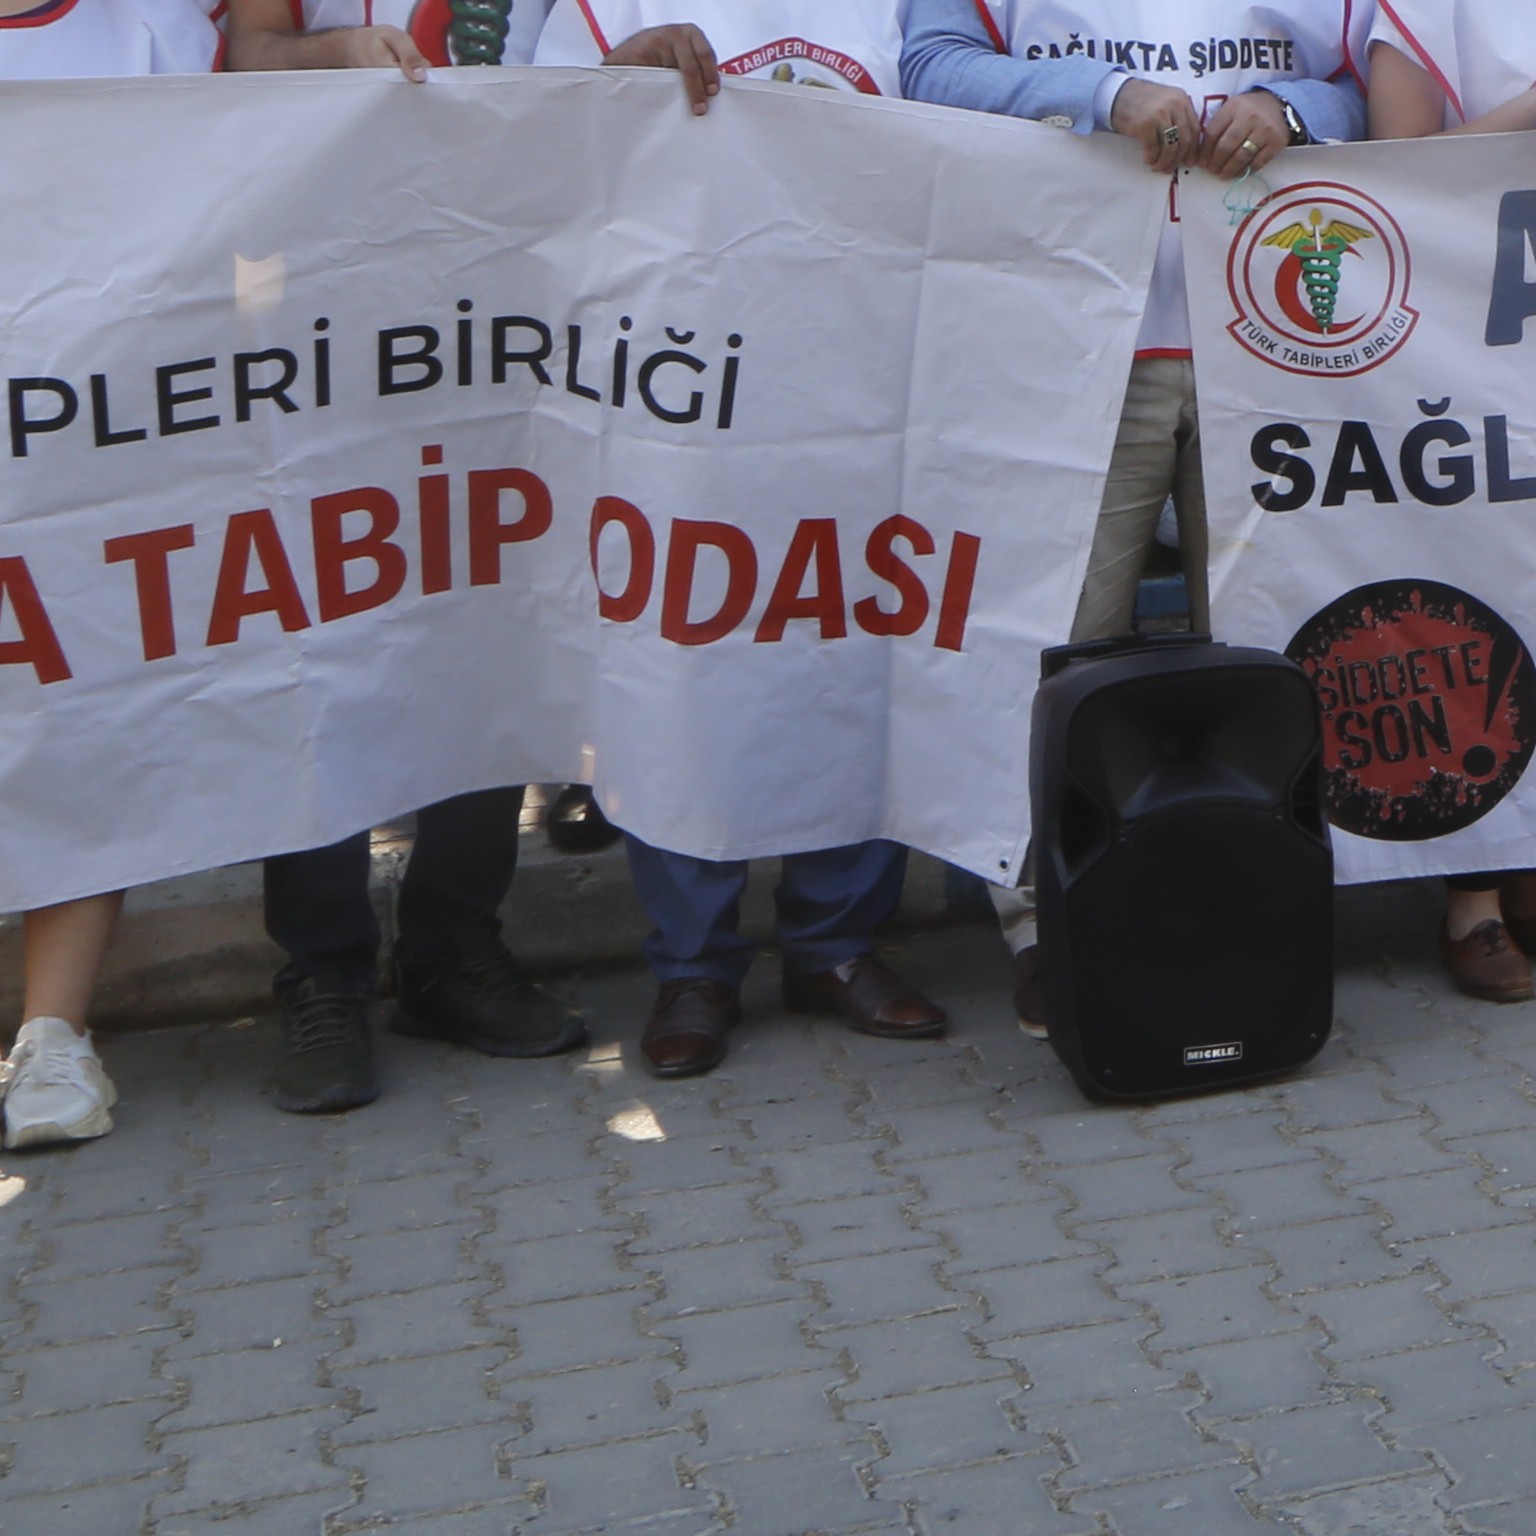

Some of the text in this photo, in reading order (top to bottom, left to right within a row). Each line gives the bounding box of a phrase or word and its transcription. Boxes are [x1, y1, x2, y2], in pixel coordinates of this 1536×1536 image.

[731, 41, 865, 83] TABİPLERİ BİRLİĞİ
[1189, 37, 1295, 78] ŞİDDETE
[377, 298, 743, 430] BİRLİĞİ
[1241, 311, 1409, 369] TÜRK TABİPLERİ BİRLİĞİ
[103, 444, 553, 661] TABİP
[588, 493, 982, 653] ODASI
